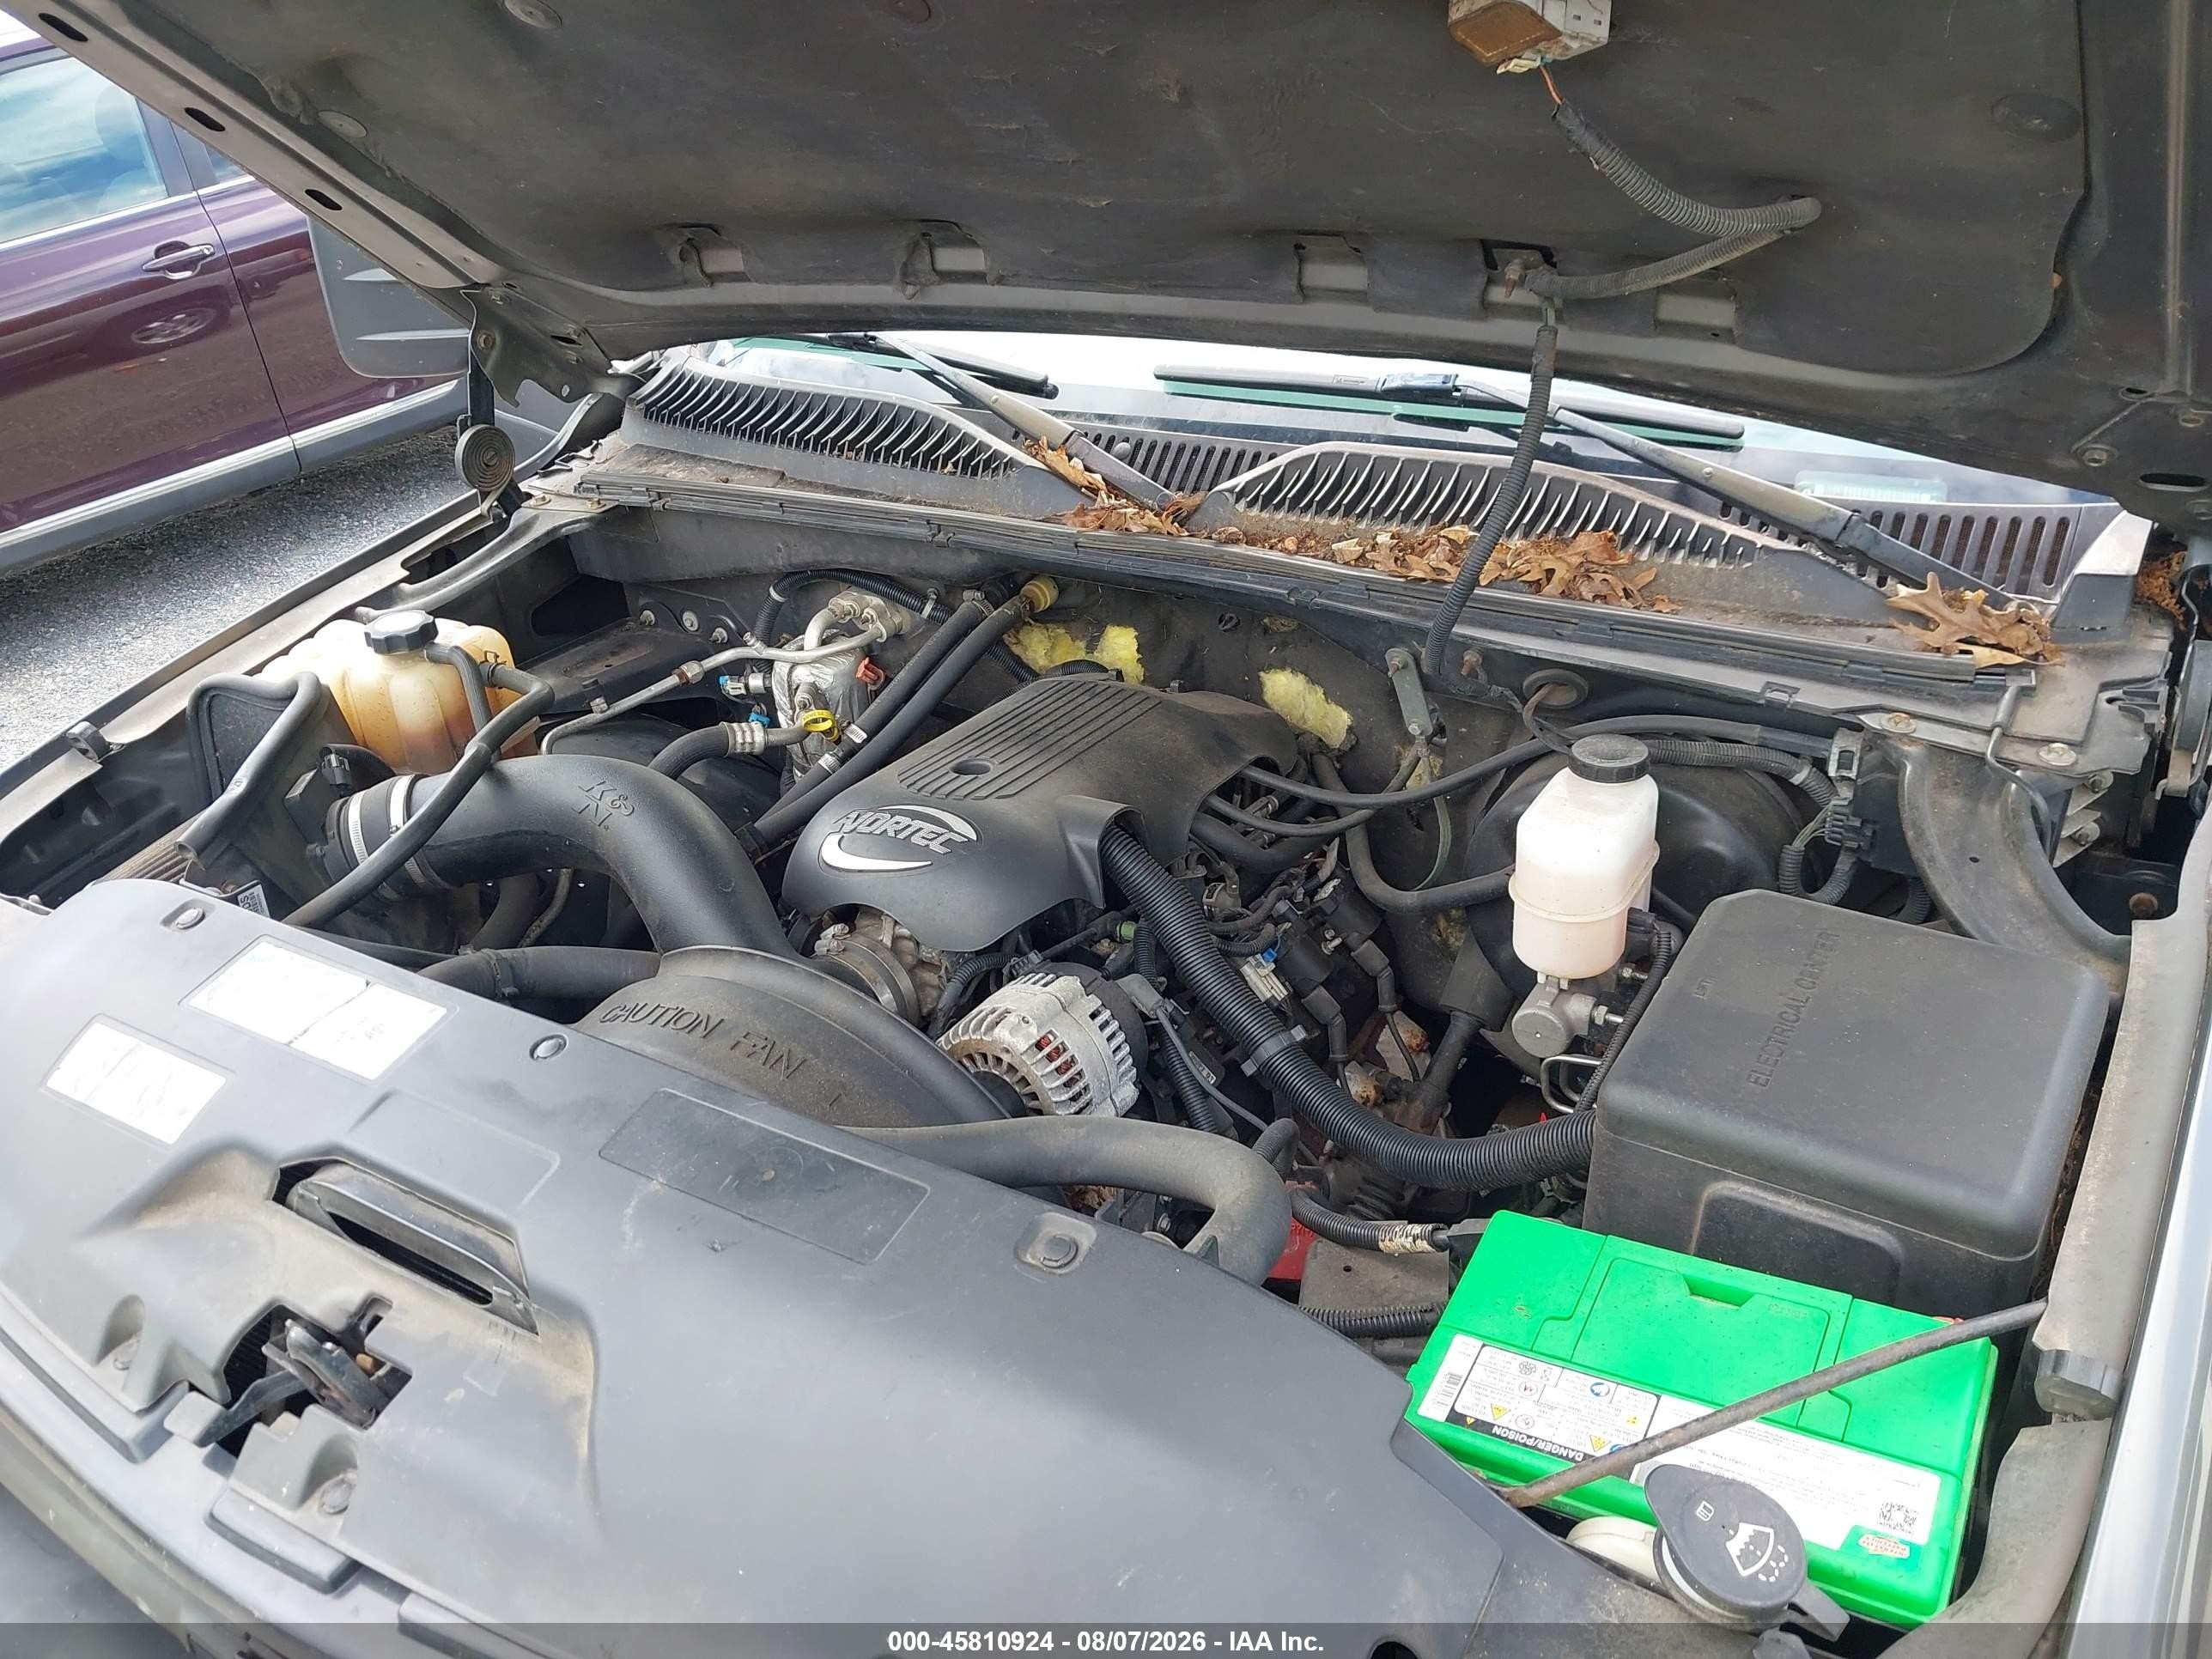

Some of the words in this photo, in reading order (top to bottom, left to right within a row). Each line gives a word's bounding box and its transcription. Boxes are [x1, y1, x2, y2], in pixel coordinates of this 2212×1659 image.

[833, 811, 969, 855] VORTEC
[599, 1001, 726, 1039] CAUTION
[730, 1030, 808, 1080] FAN
[1746, 994, 1812, 1089] ELECTRICAL
[1492, 1424, 1584, 1462] DANGER/POISON
